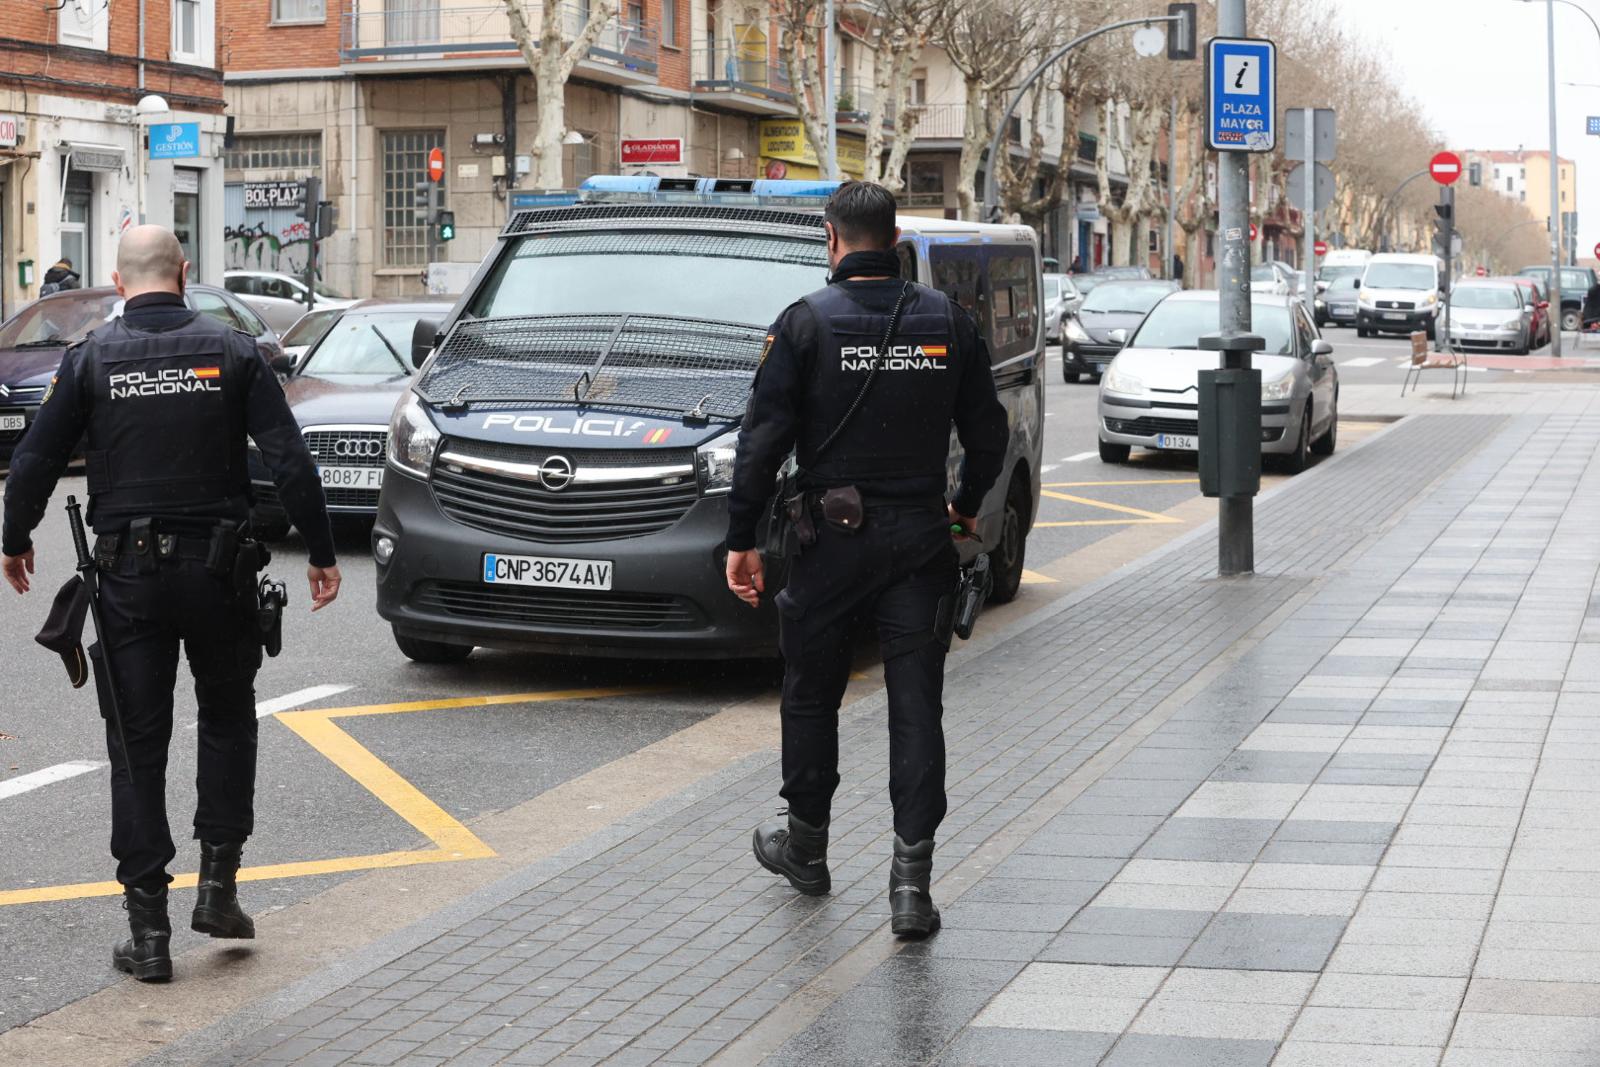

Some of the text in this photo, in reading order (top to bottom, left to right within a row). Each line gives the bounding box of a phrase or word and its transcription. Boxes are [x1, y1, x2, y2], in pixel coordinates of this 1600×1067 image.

[1222, 103, 1262, 115] PLAZA
[1220, 117, 1264, 130] MAYOR
[841, 345, 926, 358] POLICIA
[109, 368, 198, 387] POLICIA
[110, 380, 221, 400] NACIONAL
[4, 417, 23, 428] DBS
[1164, 437, 1191, 448] 0134
[323, 469, 362, 485] 8087
